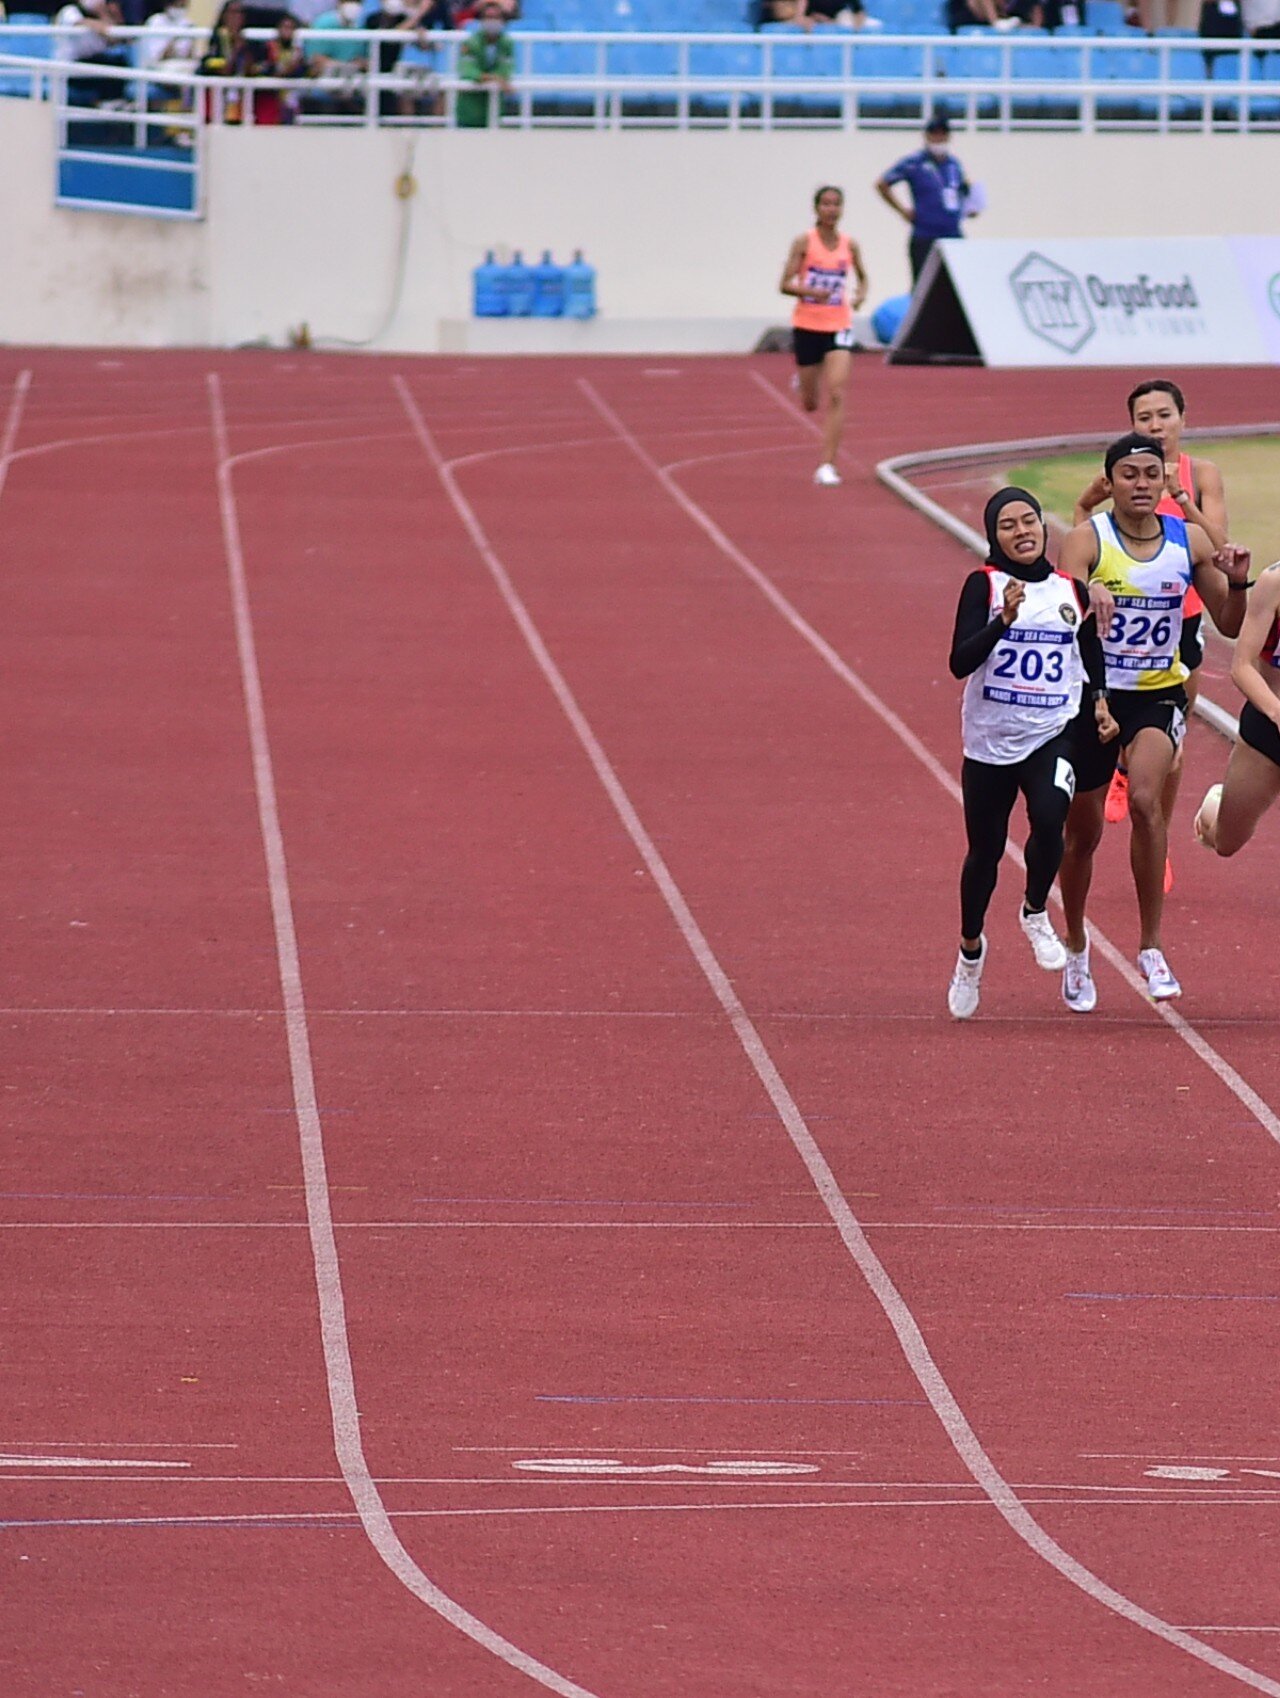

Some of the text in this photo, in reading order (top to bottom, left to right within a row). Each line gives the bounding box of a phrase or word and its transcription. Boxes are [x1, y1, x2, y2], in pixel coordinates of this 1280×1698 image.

[1087, 274, 1198, 316] OrgaFood
[1023, 631, 1038, 641] SEA
[993, 648, 1064, 683] 203
